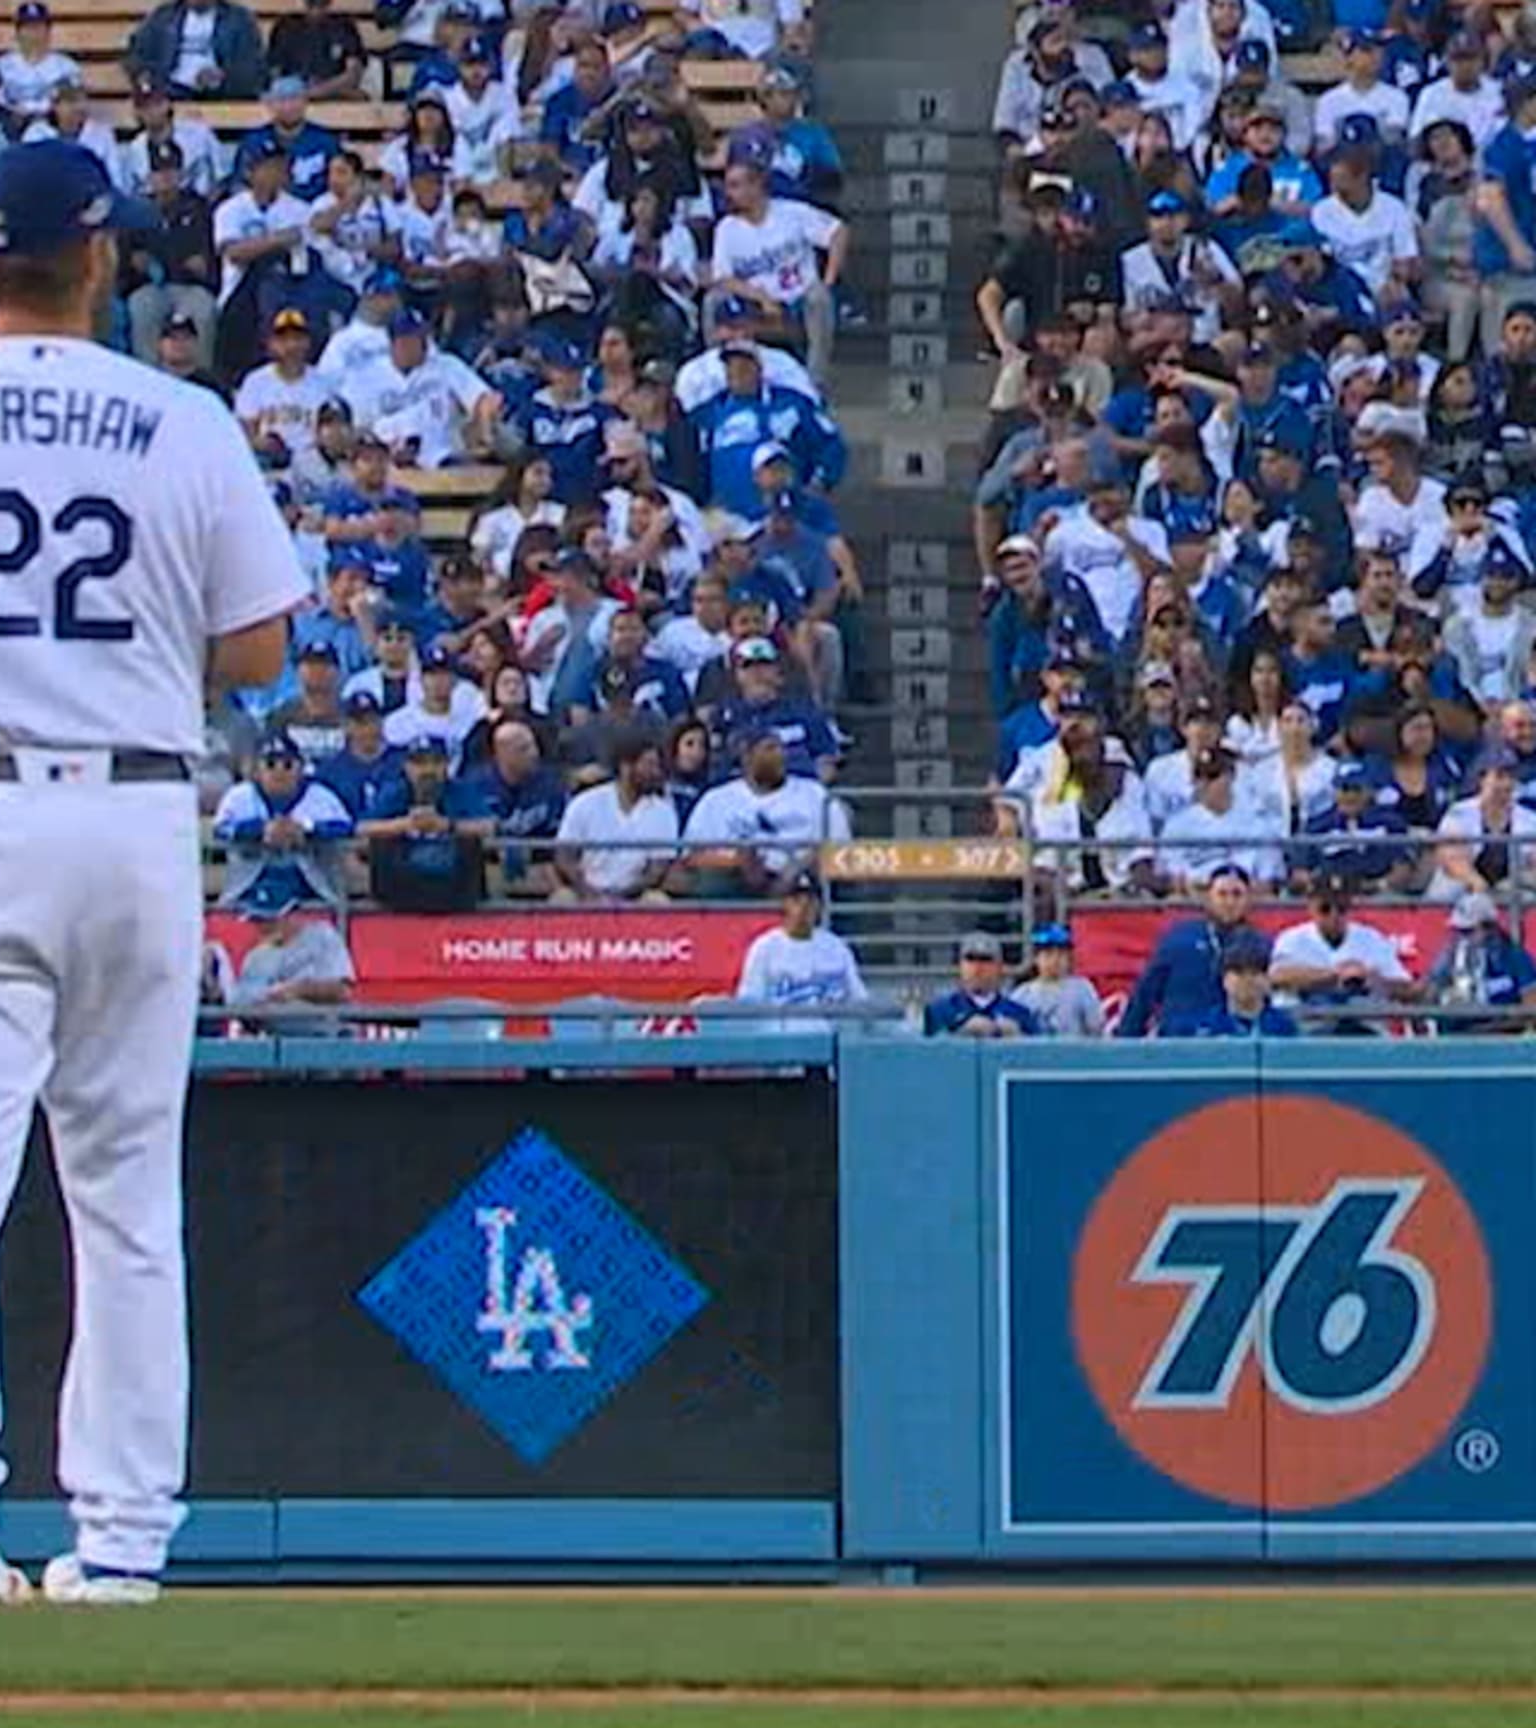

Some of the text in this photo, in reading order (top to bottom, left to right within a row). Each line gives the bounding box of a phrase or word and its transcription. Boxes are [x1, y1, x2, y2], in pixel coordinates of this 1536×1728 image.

[444, 938, 693, 962] HOME RUN MAGIC
[476, 1207, 594, 1370] LA
[1129, 1176, 1437, 1414] 76
